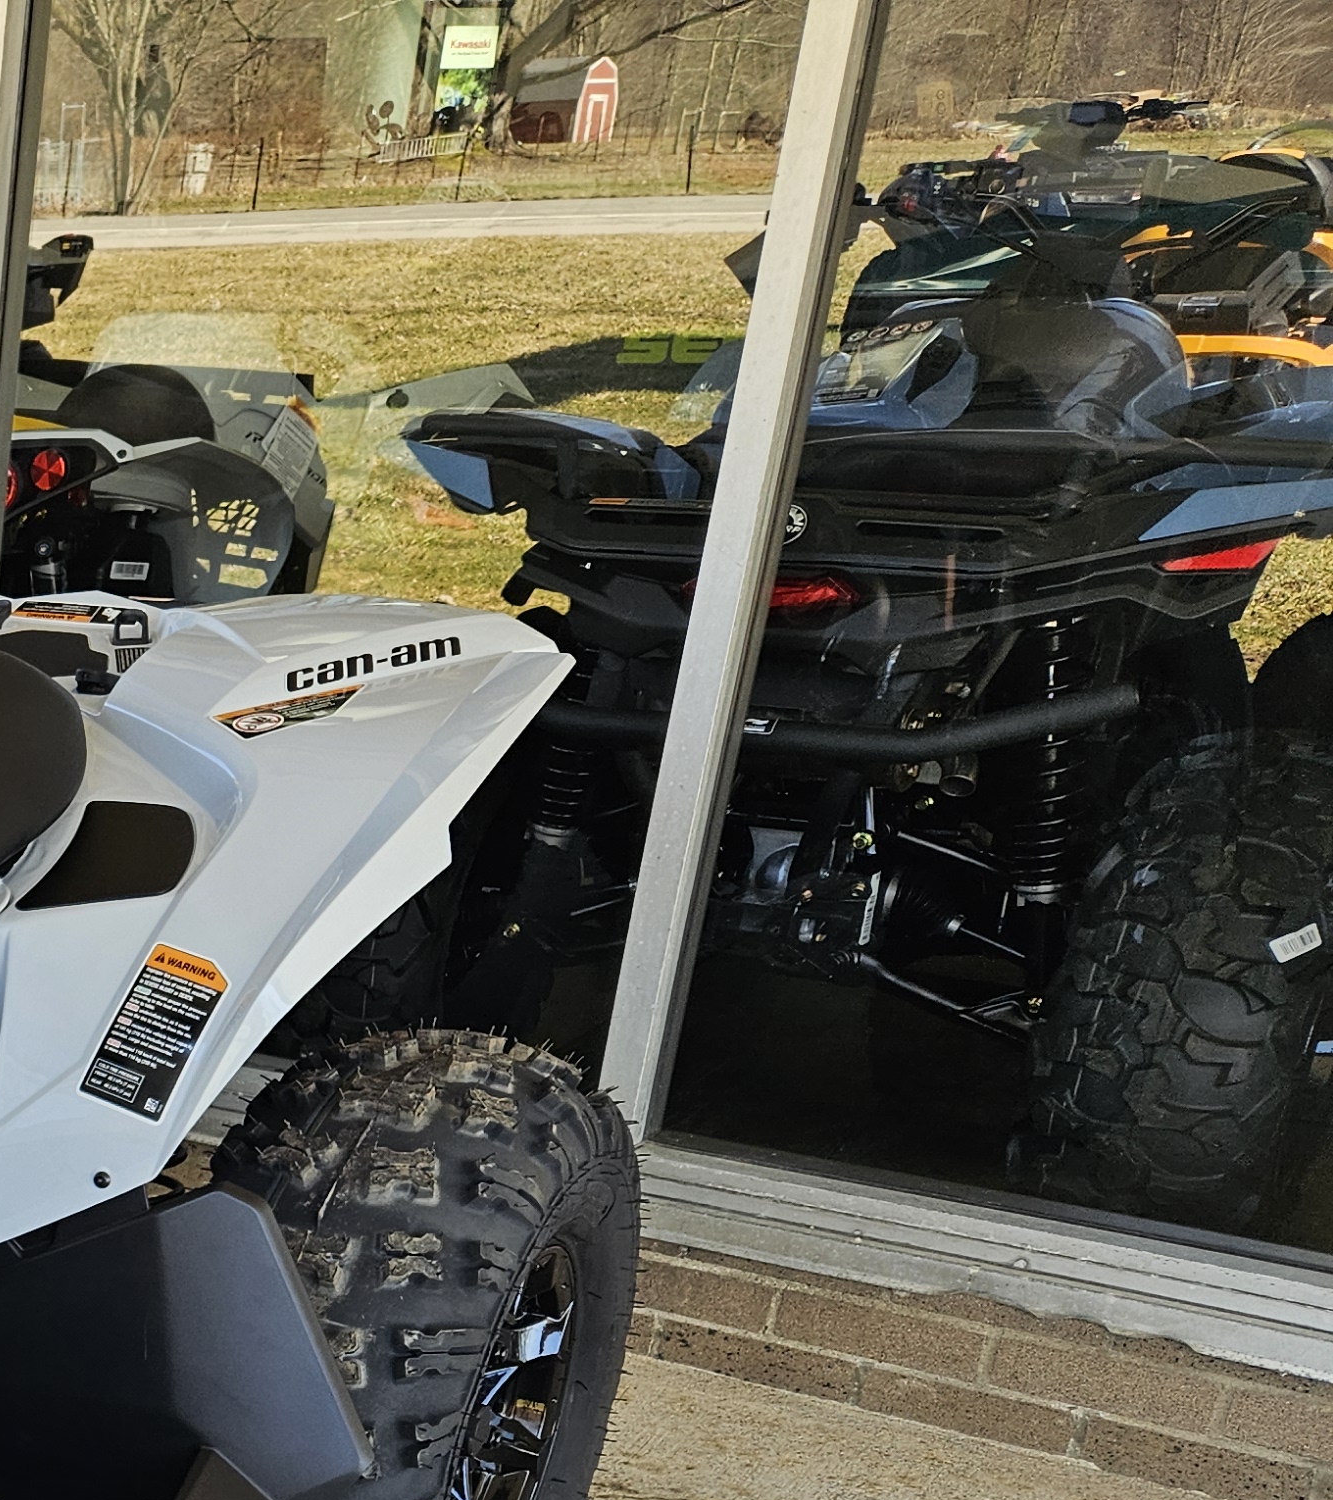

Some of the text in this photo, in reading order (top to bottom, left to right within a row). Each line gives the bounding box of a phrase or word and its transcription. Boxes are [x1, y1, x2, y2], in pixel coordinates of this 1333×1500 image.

[450, 39, 491, 49] Kawasaki
[286, 636, 462, 693] can-am
[167, 956, 217, 981] WARNING
